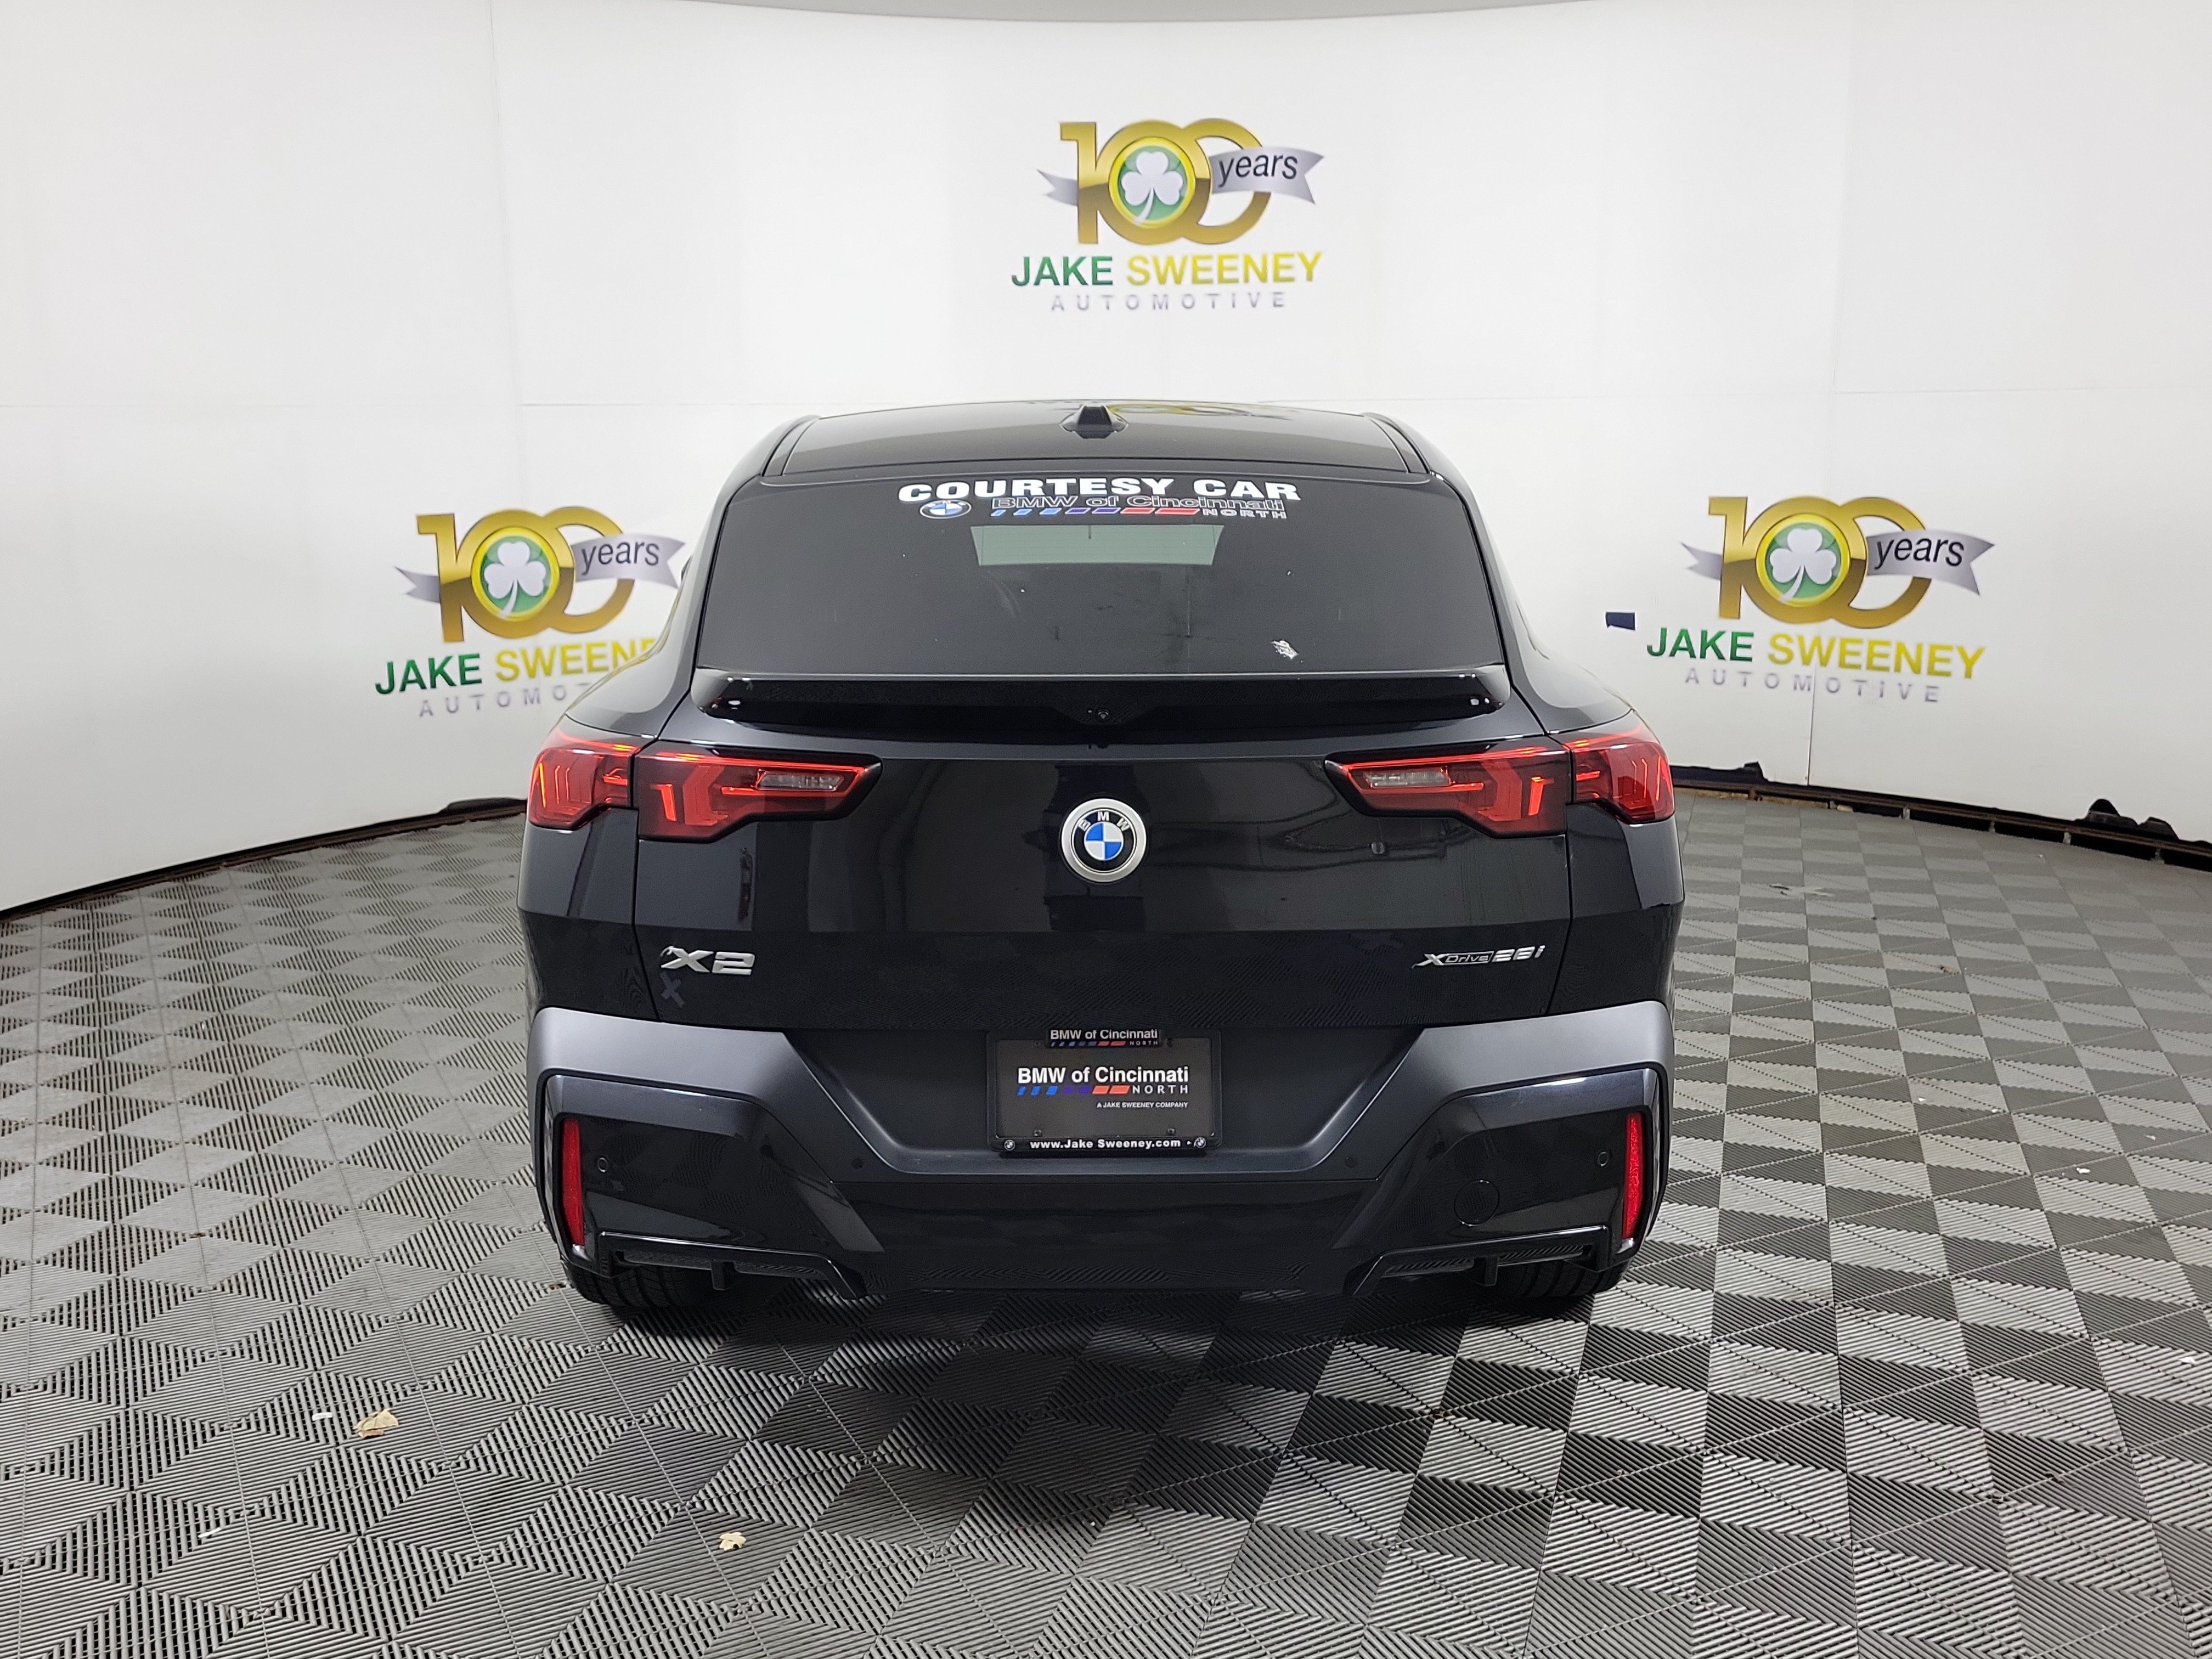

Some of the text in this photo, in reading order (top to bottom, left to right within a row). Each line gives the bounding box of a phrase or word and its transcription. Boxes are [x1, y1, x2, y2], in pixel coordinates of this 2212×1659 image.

[1059, 118, 1298, 245] 100 years
[1011, 251, 1323, 286] JAKE SWEENEY
[1051, 292, 1285, 311] AUTOMOTIVE
[898, 477, 1301, 501] COURTESY CAR
[991, 495, 1284, 511] BMW of Cincinnati
[1203, 509, 1286, 519] NORTH
[416, 506, 659, 643] 100 years
[1708, 496, 1965, 629] 100 years
[1646, 627, 1985, 679] JAKE SWEENEY
[375, 638, 656, 695] JAKE SWEEN
[1685, 668, 1940, 703] AUTOMOTIVE
[420, 682, 590, 717] AUTOMO
[1078, 811, 1131, 832] BMW
[661, 946, 755, 975] X2
[1051, 1029, 1158, 1039] BMW of Cincinnati
[1018, 1066, 1188, 1084] BMW of Cincinnati
[1132, 1085, 1188, 1094] NORTH
[1030, 1139, 1181, 1149] www.Jake Sweeney.com
